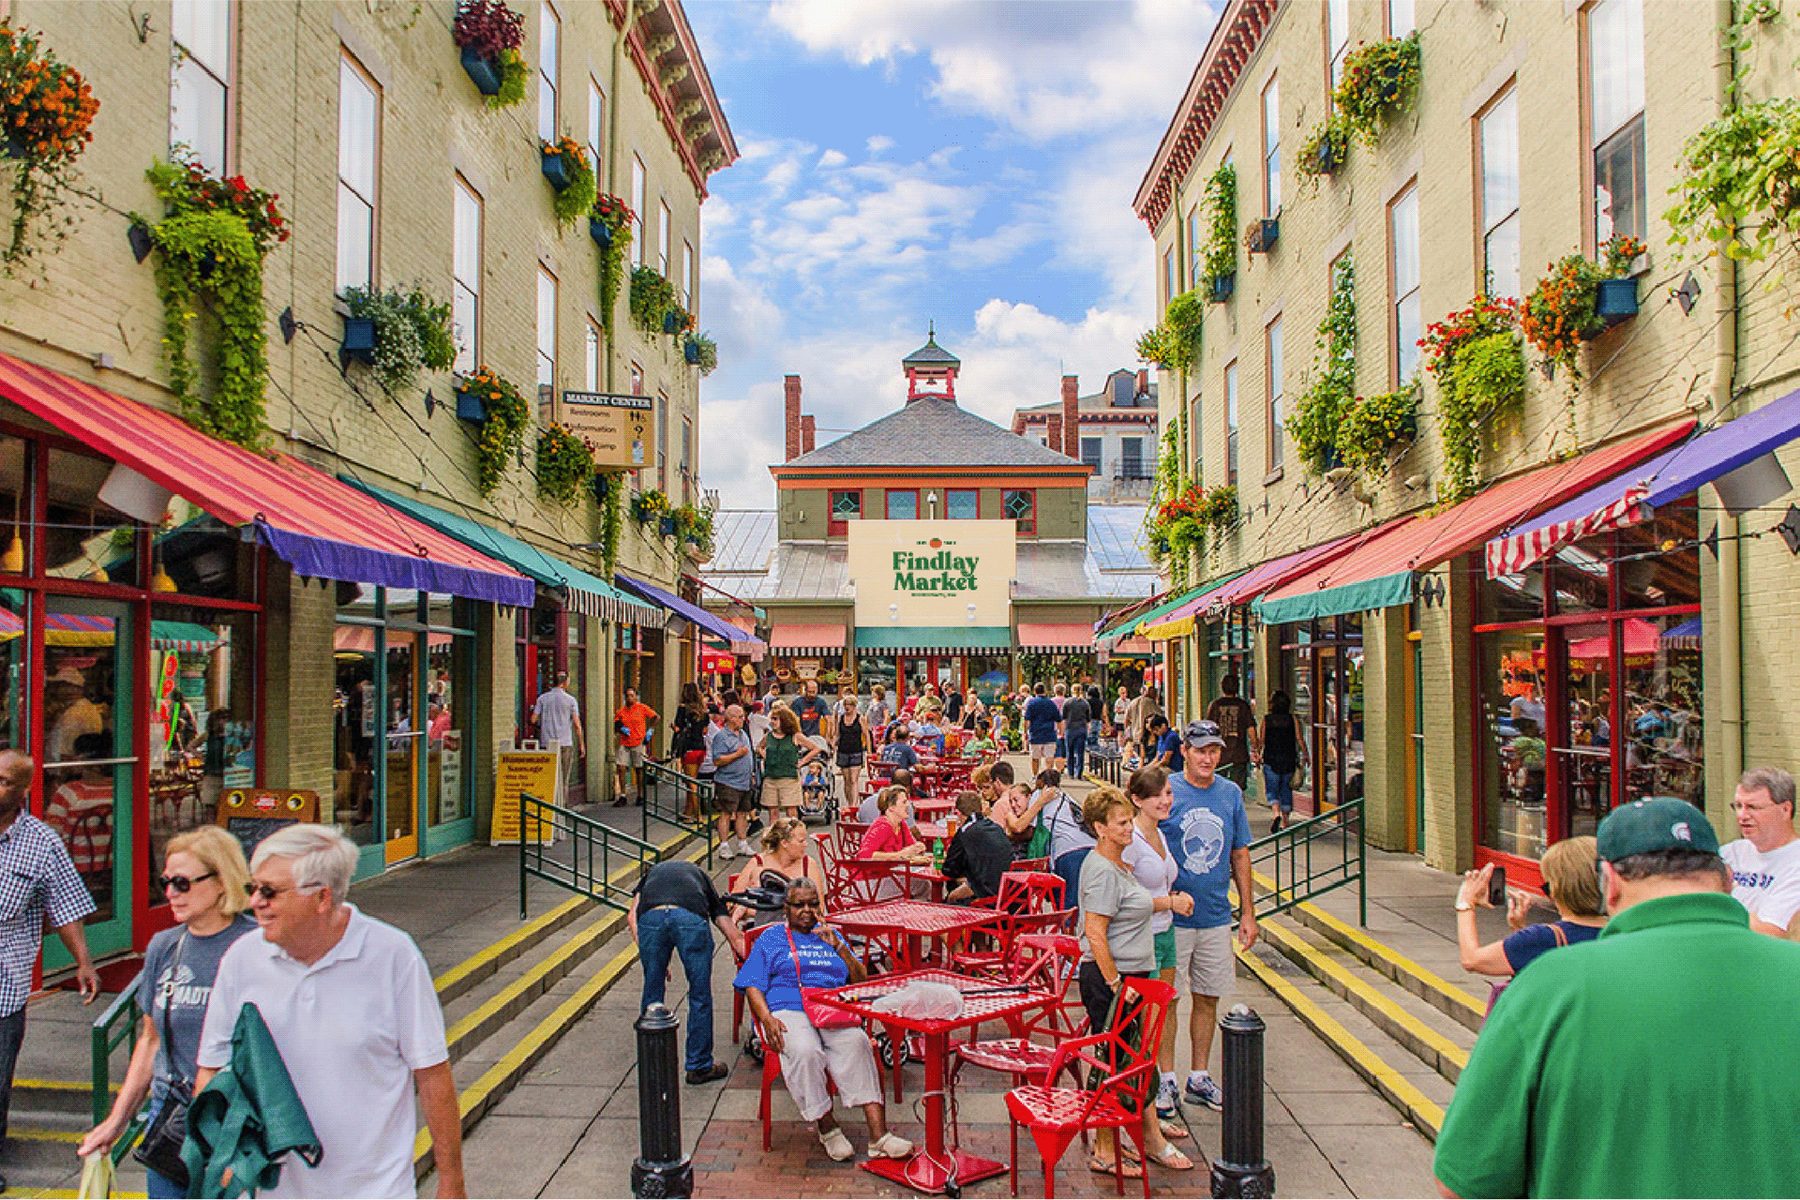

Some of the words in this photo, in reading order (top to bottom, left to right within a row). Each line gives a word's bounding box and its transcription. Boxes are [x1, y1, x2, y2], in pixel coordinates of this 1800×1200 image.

[566, 393, 610, 404] MARKET
[611, 398, 651, 408] CENTER
[892, 551, 980, 578] Findlay
[893, 571, 978, 591] Market
[507, 765, 544, 774] Sausage
